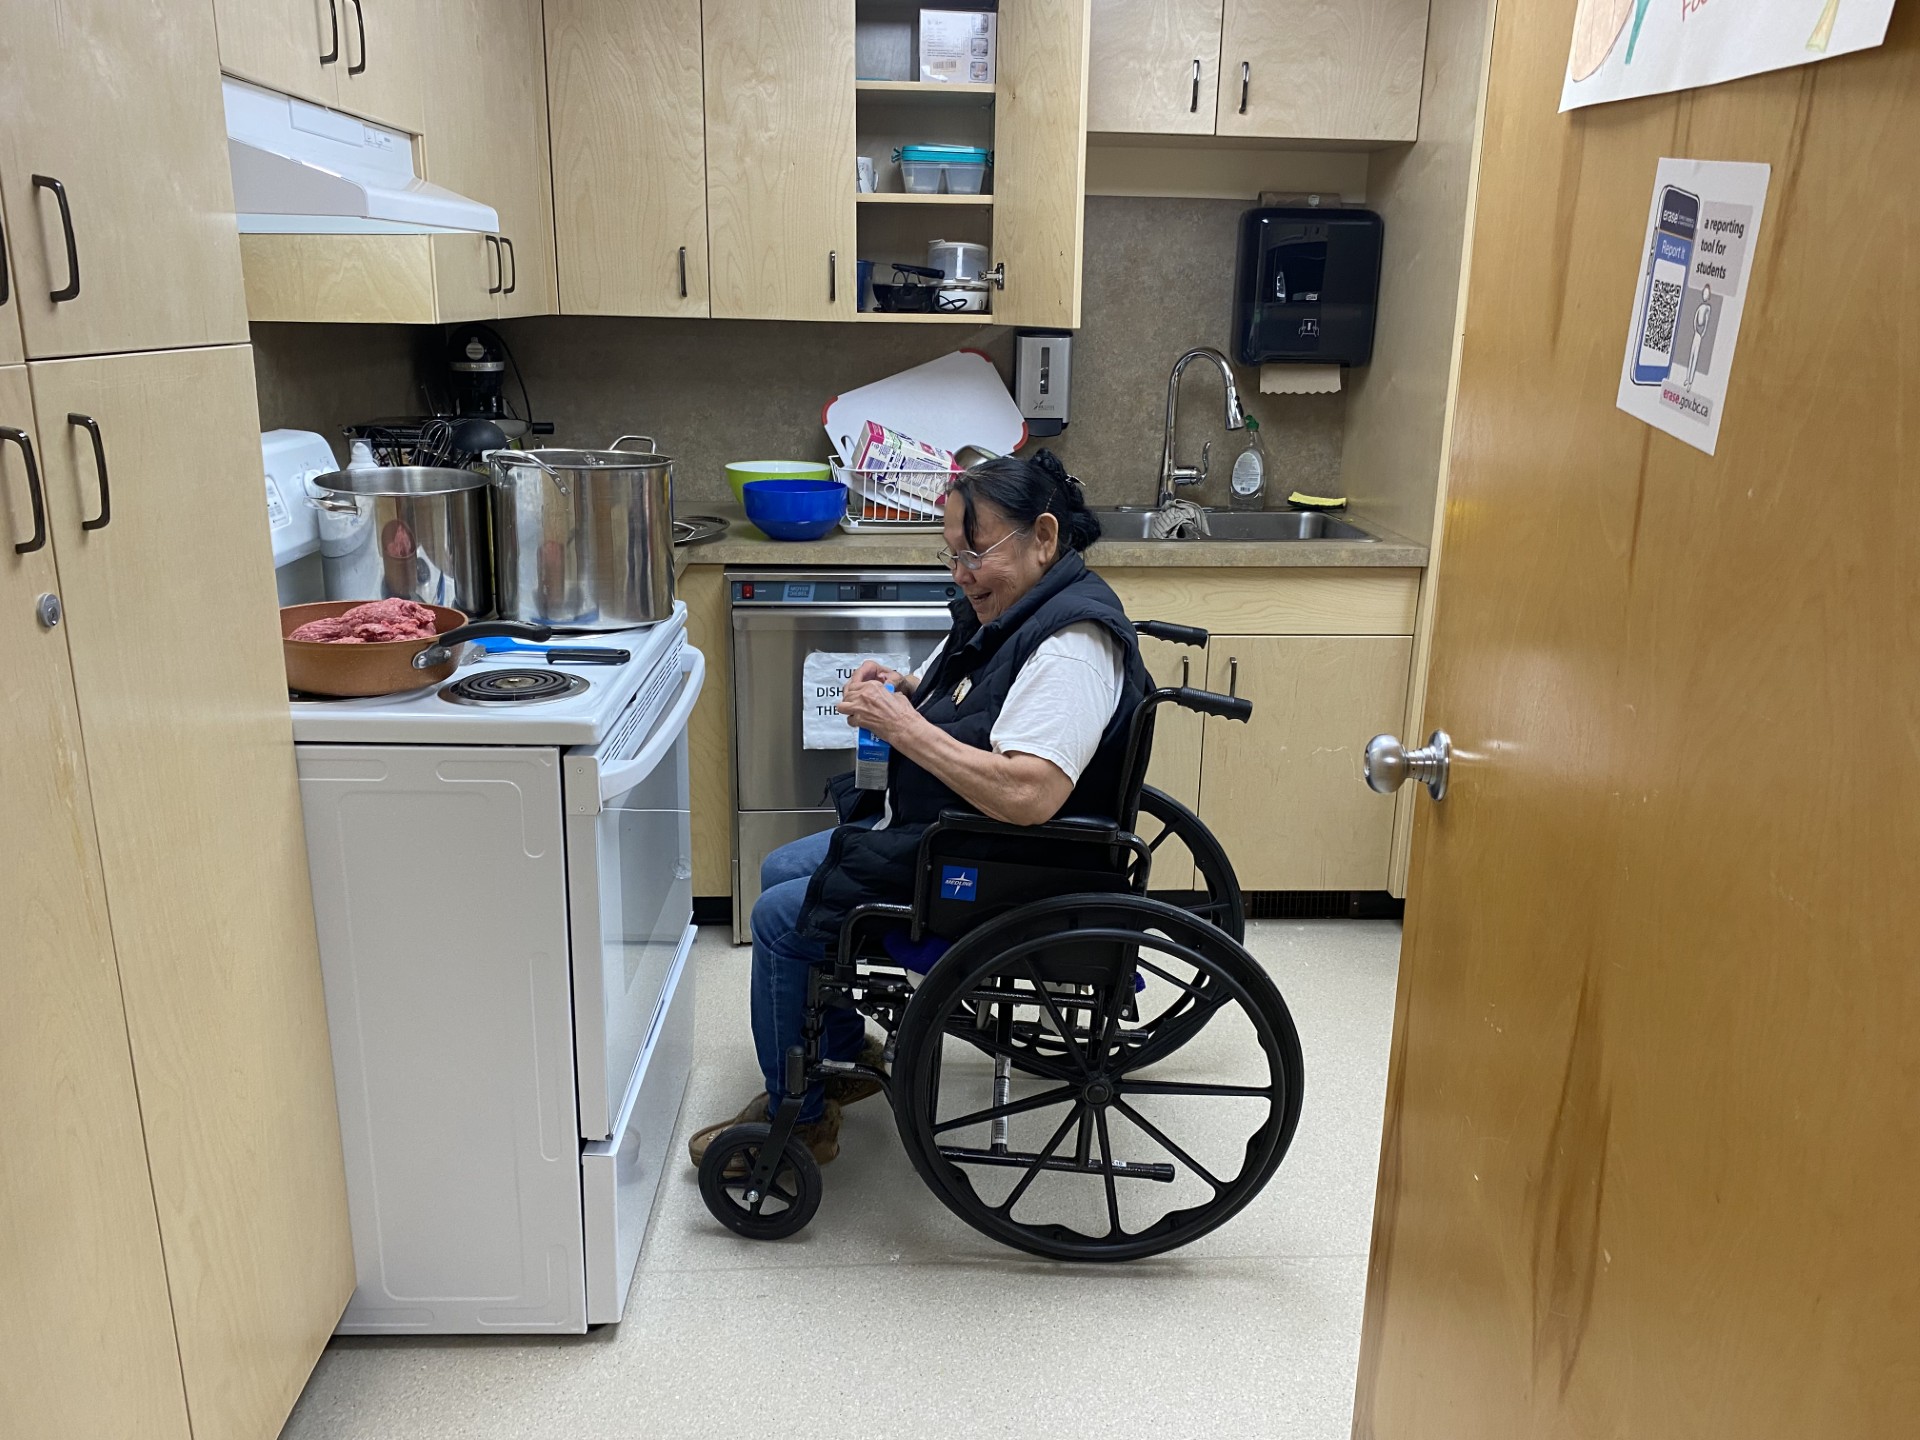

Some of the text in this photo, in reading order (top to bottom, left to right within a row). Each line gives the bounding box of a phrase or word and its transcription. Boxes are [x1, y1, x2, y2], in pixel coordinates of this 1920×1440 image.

[1682, 0, 1708, 23] Fo
[1662, 209, 1679, 224] erase
[1704, 219, 1709, 229] a
[1710, 219, 1745, 239] reporting
[1661, 239, 1681, 259] Report
[1700, 239, 1727, 256] tool for
[1696, 261, 1727, 279] students
[1663, 388, 1709, 418] erase.gov.bc.ca
[836, 668, 856, 679] TU
